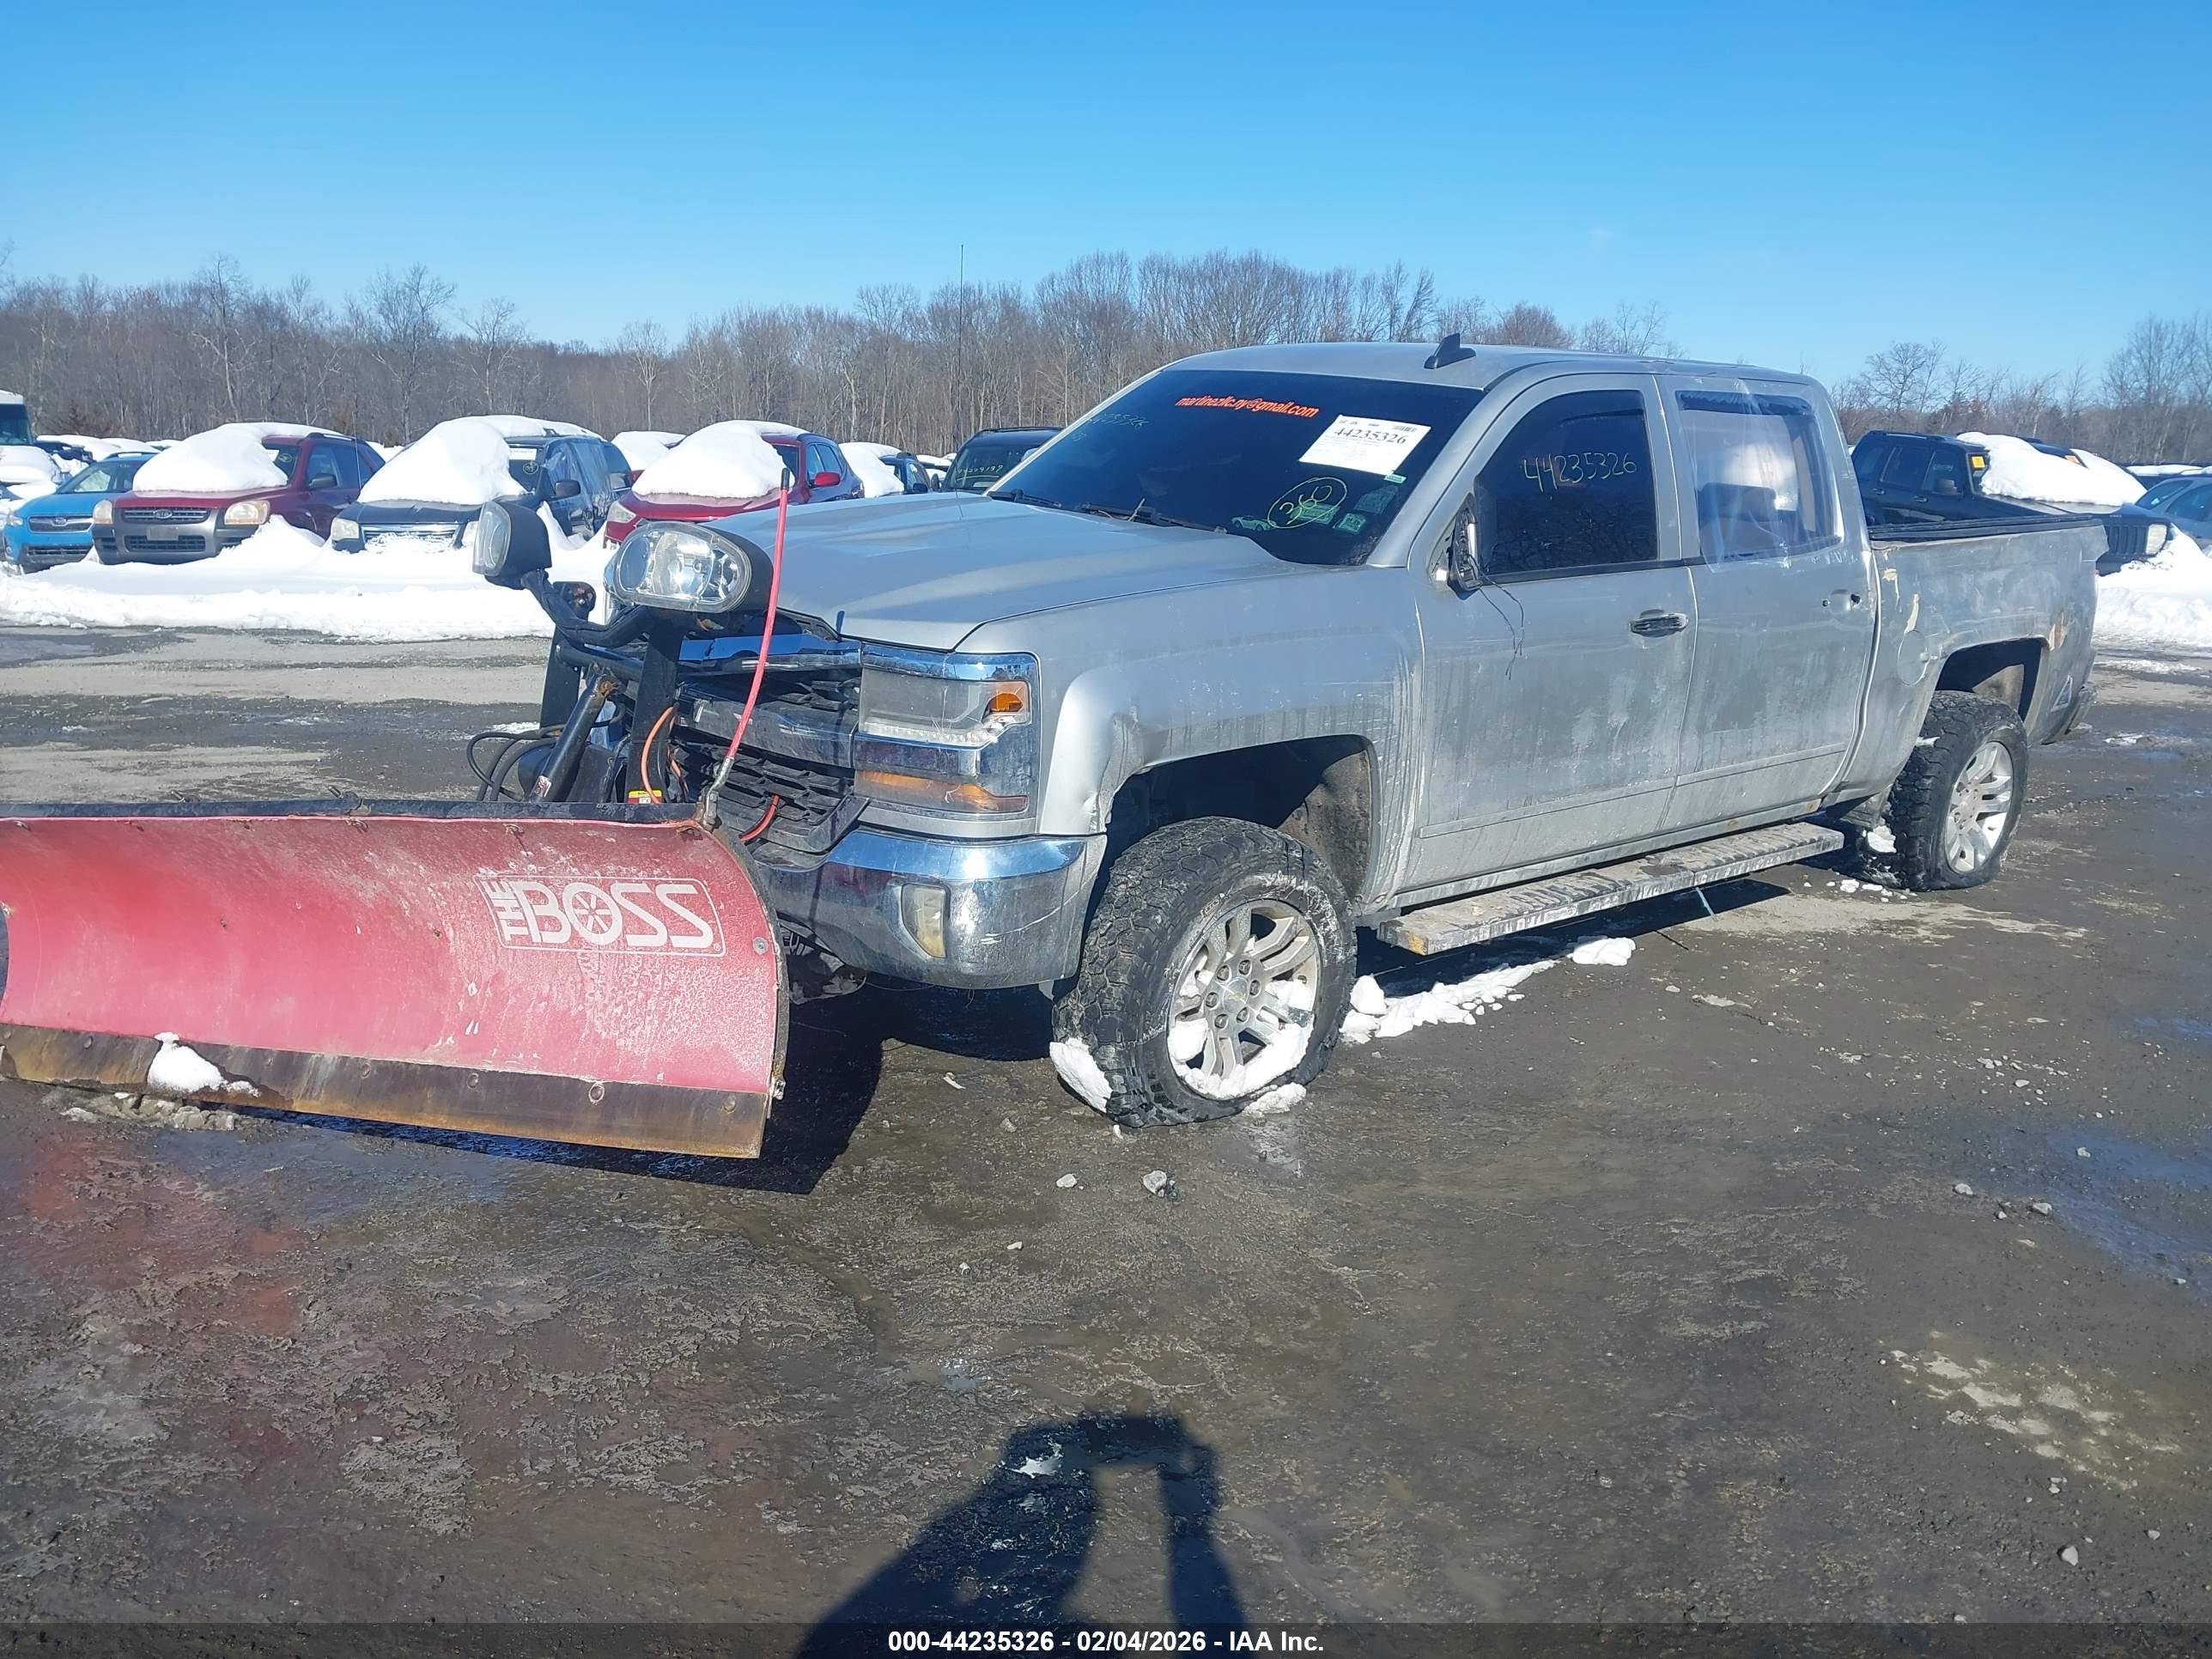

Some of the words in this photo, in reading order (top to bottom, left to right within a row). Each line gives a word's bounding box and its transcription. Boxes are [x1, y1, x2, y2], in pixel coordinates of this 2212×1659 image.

[1175, 395, 1320, 418] martinezllc.ny@gmail.com
[1334, 428, 1408, 445] 44235326
[1523, 453, 1637, 492] 44235326
[483, 880, 529, 942] THE
[515, 881, 714, 949] BOSS
